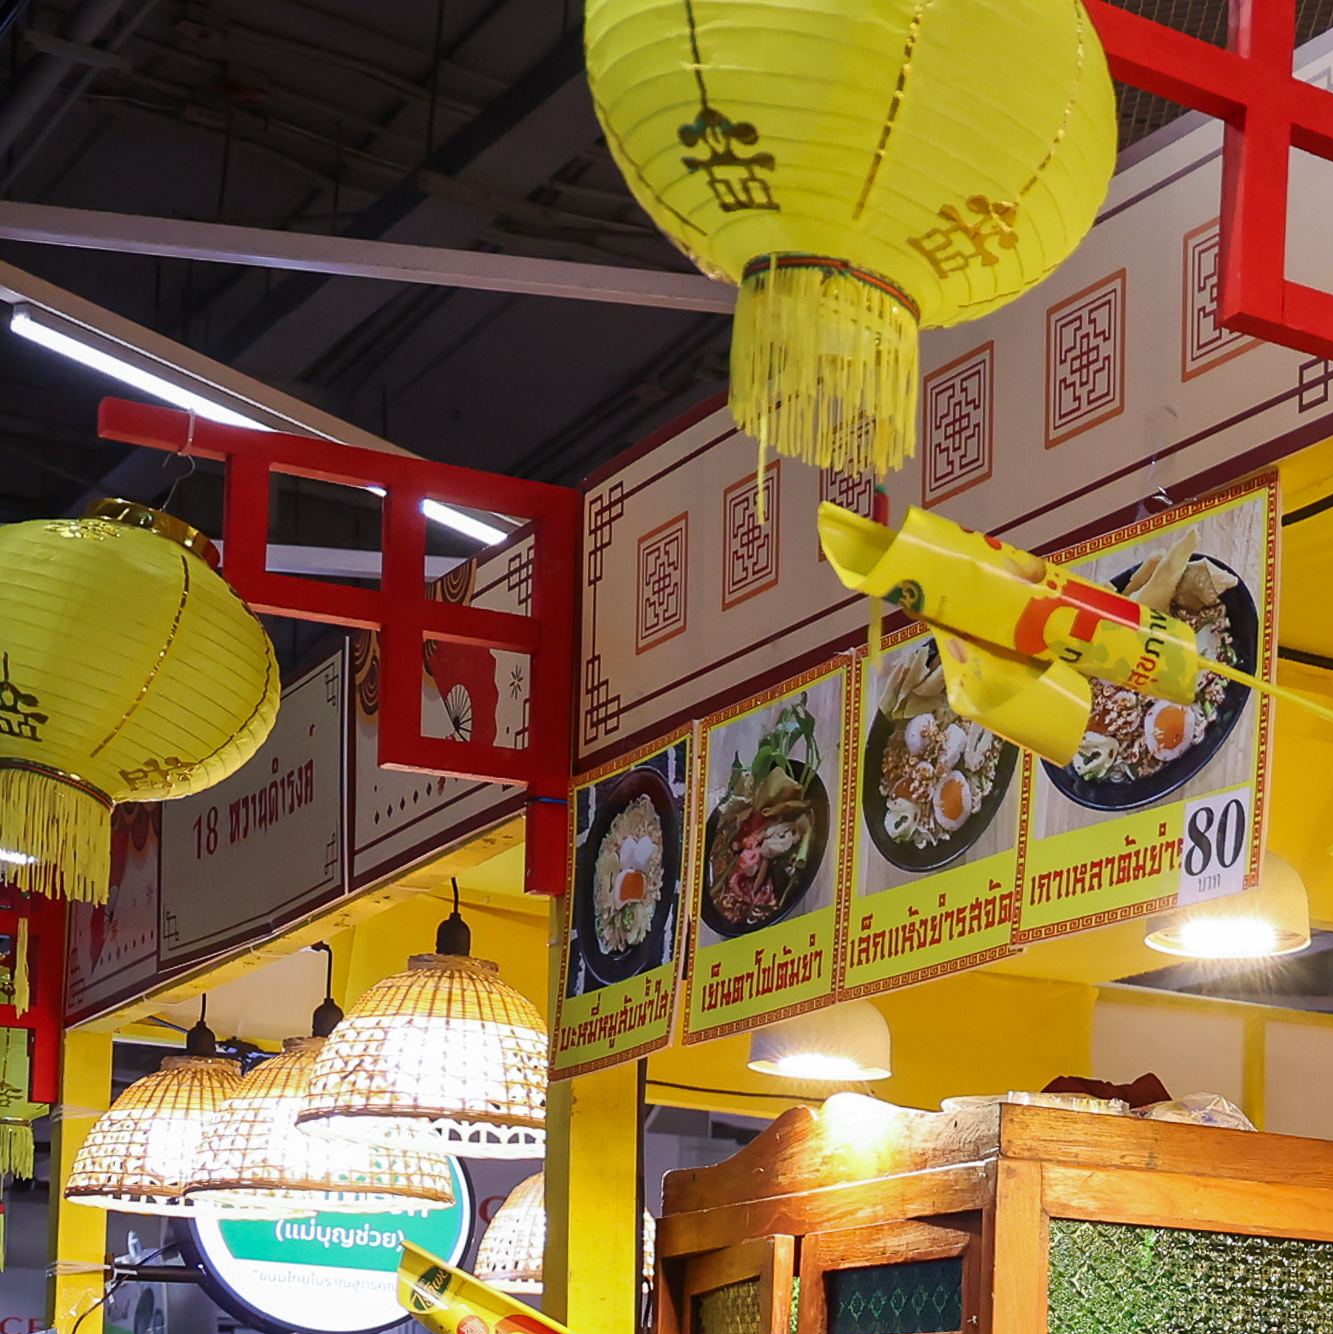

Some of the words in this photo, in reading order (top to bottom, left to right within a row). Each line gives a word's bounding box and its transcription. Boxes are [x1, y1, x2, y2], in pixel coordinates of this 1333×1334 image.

[193, 806, 218, 860] 18
[1184, 799, 1247, 877] 80
[275, 1219, 406, 1250] (แม่บุญช่วย)
